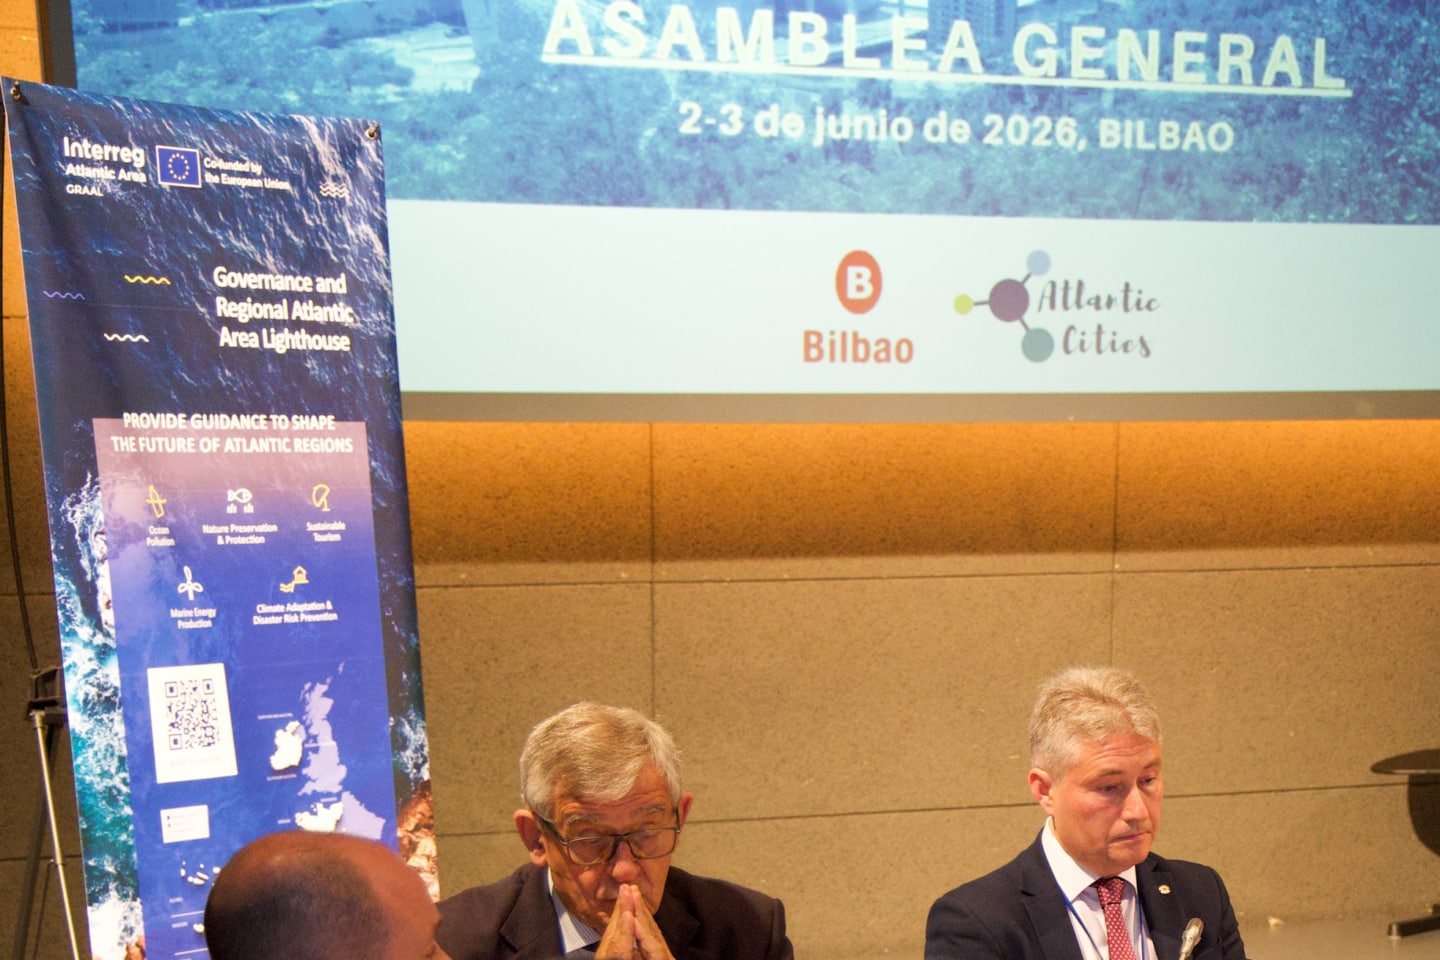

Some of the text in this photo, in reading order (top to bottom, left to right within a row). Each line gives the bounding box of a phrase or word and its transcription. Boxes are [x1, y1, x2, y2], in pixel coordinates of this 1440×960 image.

[543, 0, 1346, 90] ASAMBLEA GENERAL
[679, 102, 1235, 152] 2-3 de junio de 2026, BILBAO
[63, 136, 145, 168] Interreg
[65, 163, 147, 183] Atlantic Area
[203, 156, 263, 175] Co-funded by
[66, 183, 104, 197] GRAAL
[205, 171, 291, 191] the European Union
[213, 265, 347, 294] Governance and
[845, 265, 874, 300] B
[1038, 279, 1161, 313] Atlantic
[216, 296, 354, 323] Regional Atlantic
[219, 326, 351, 354] Area Lighthouse
[803, 330, 914, 363] Bilbao
[1062, 323, 1151, 358] Cities
[123, 412, 336, 431] PROVIDE GUIDANCE TO SHAPE
[111, 436, 353, 453] THE FUTURE OF ATLANTIC REGIONS
[202, 523, 278, 534] Nature Preservation
[306, 520, 346, 532] Sustainable
[146, 536, 176, 547] Pollution
[225, 534, 266, 544] Protection
[312, 532, 342, 542] Tourism
[170, 607, 217, 618] Marine Energy
[256, 603, 285, 614] Climate
[286, 601, 325, 612] Adaptation
[177, 619, 213, 630] Production
[252, 611, 339, 625] Disaster Risk Prevention
